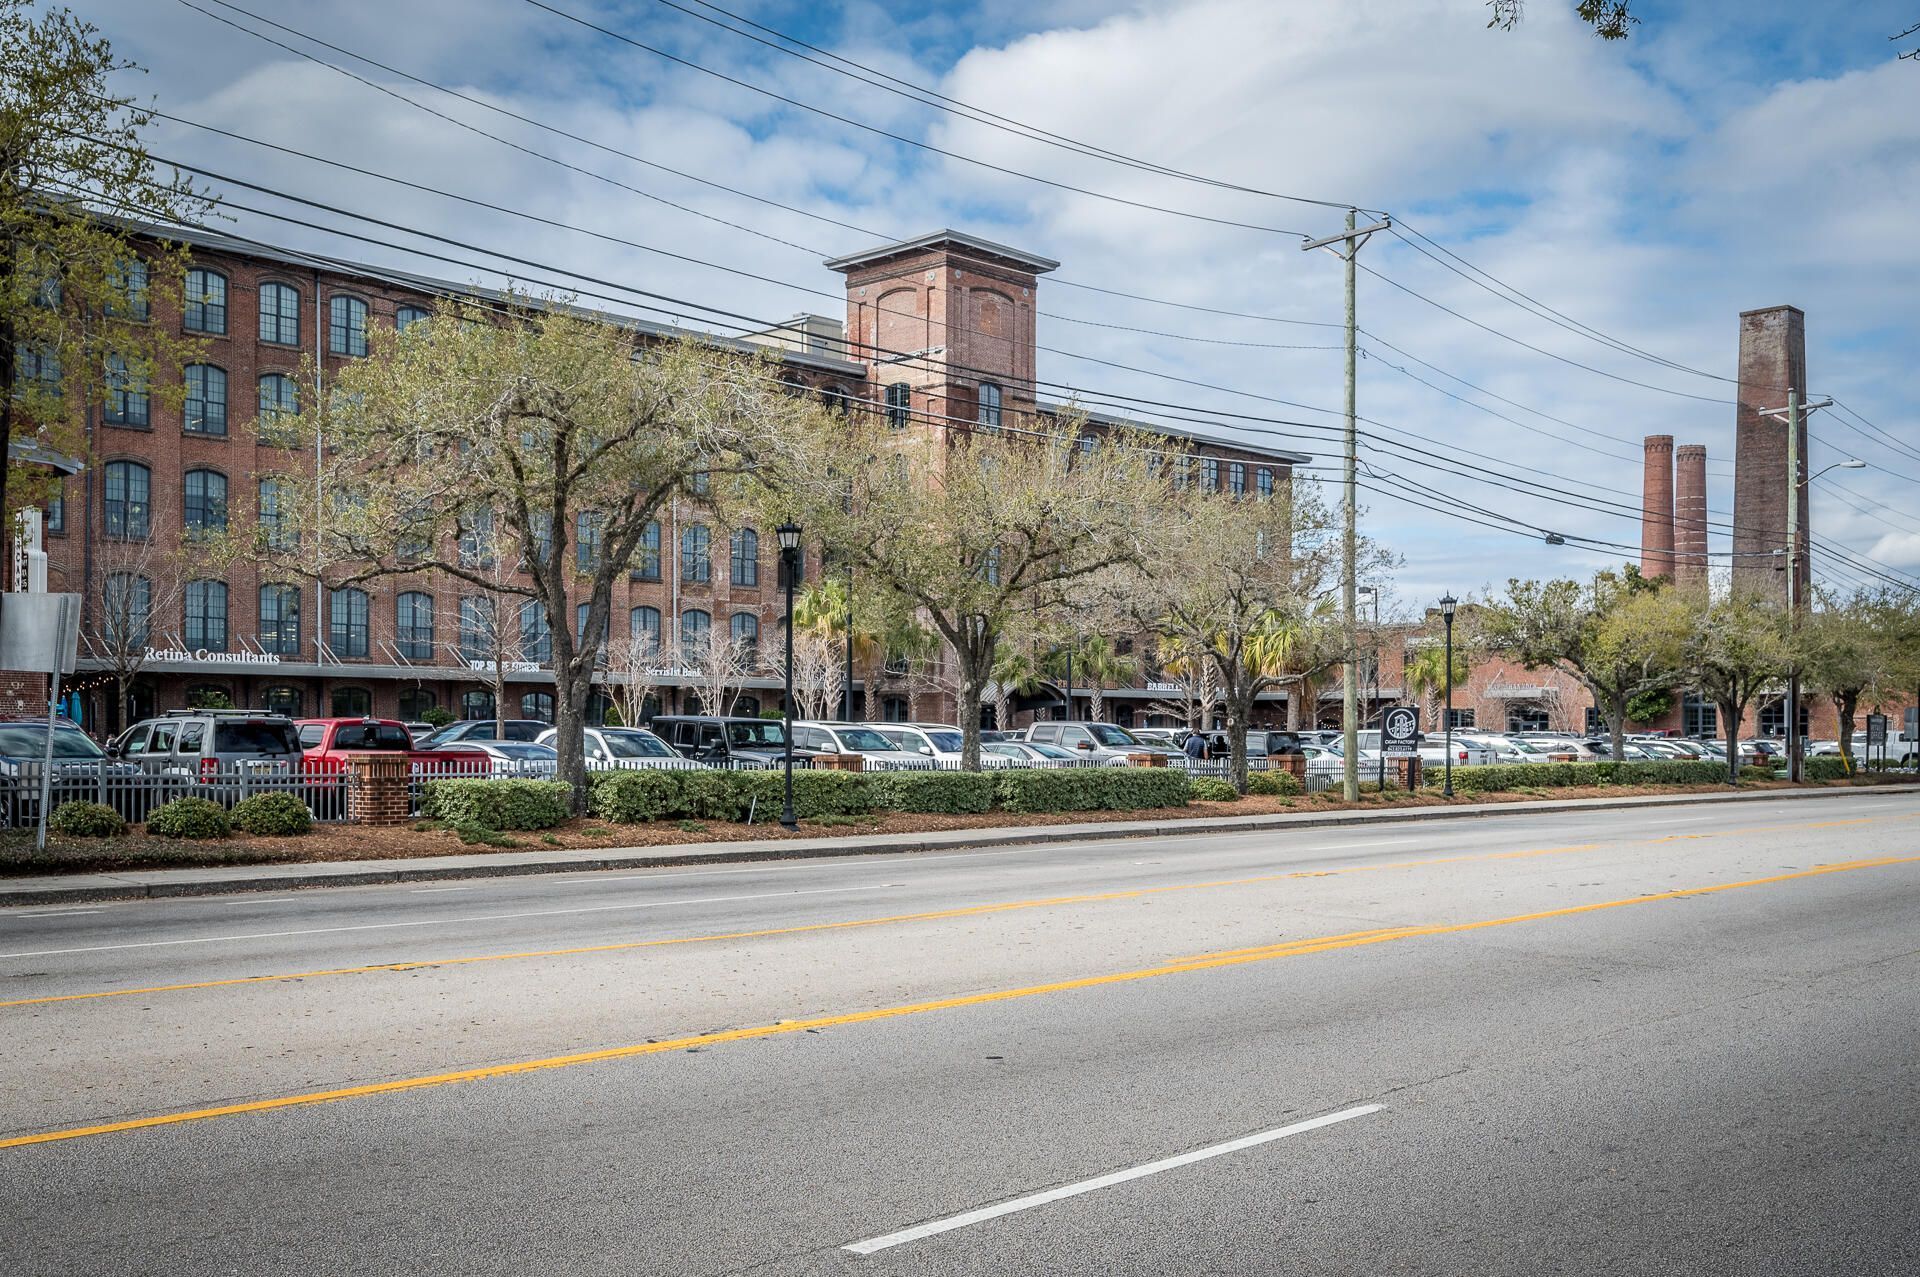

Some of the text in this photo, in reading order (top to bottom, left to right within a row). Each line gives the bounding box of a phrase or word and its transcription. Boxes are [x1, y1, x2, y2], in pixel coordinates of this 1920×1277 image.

[144, 646, 281, 664] Retina Consultants
[470, 659, 485, 672] TOP
[486, 660, 510, 673] SHPE
